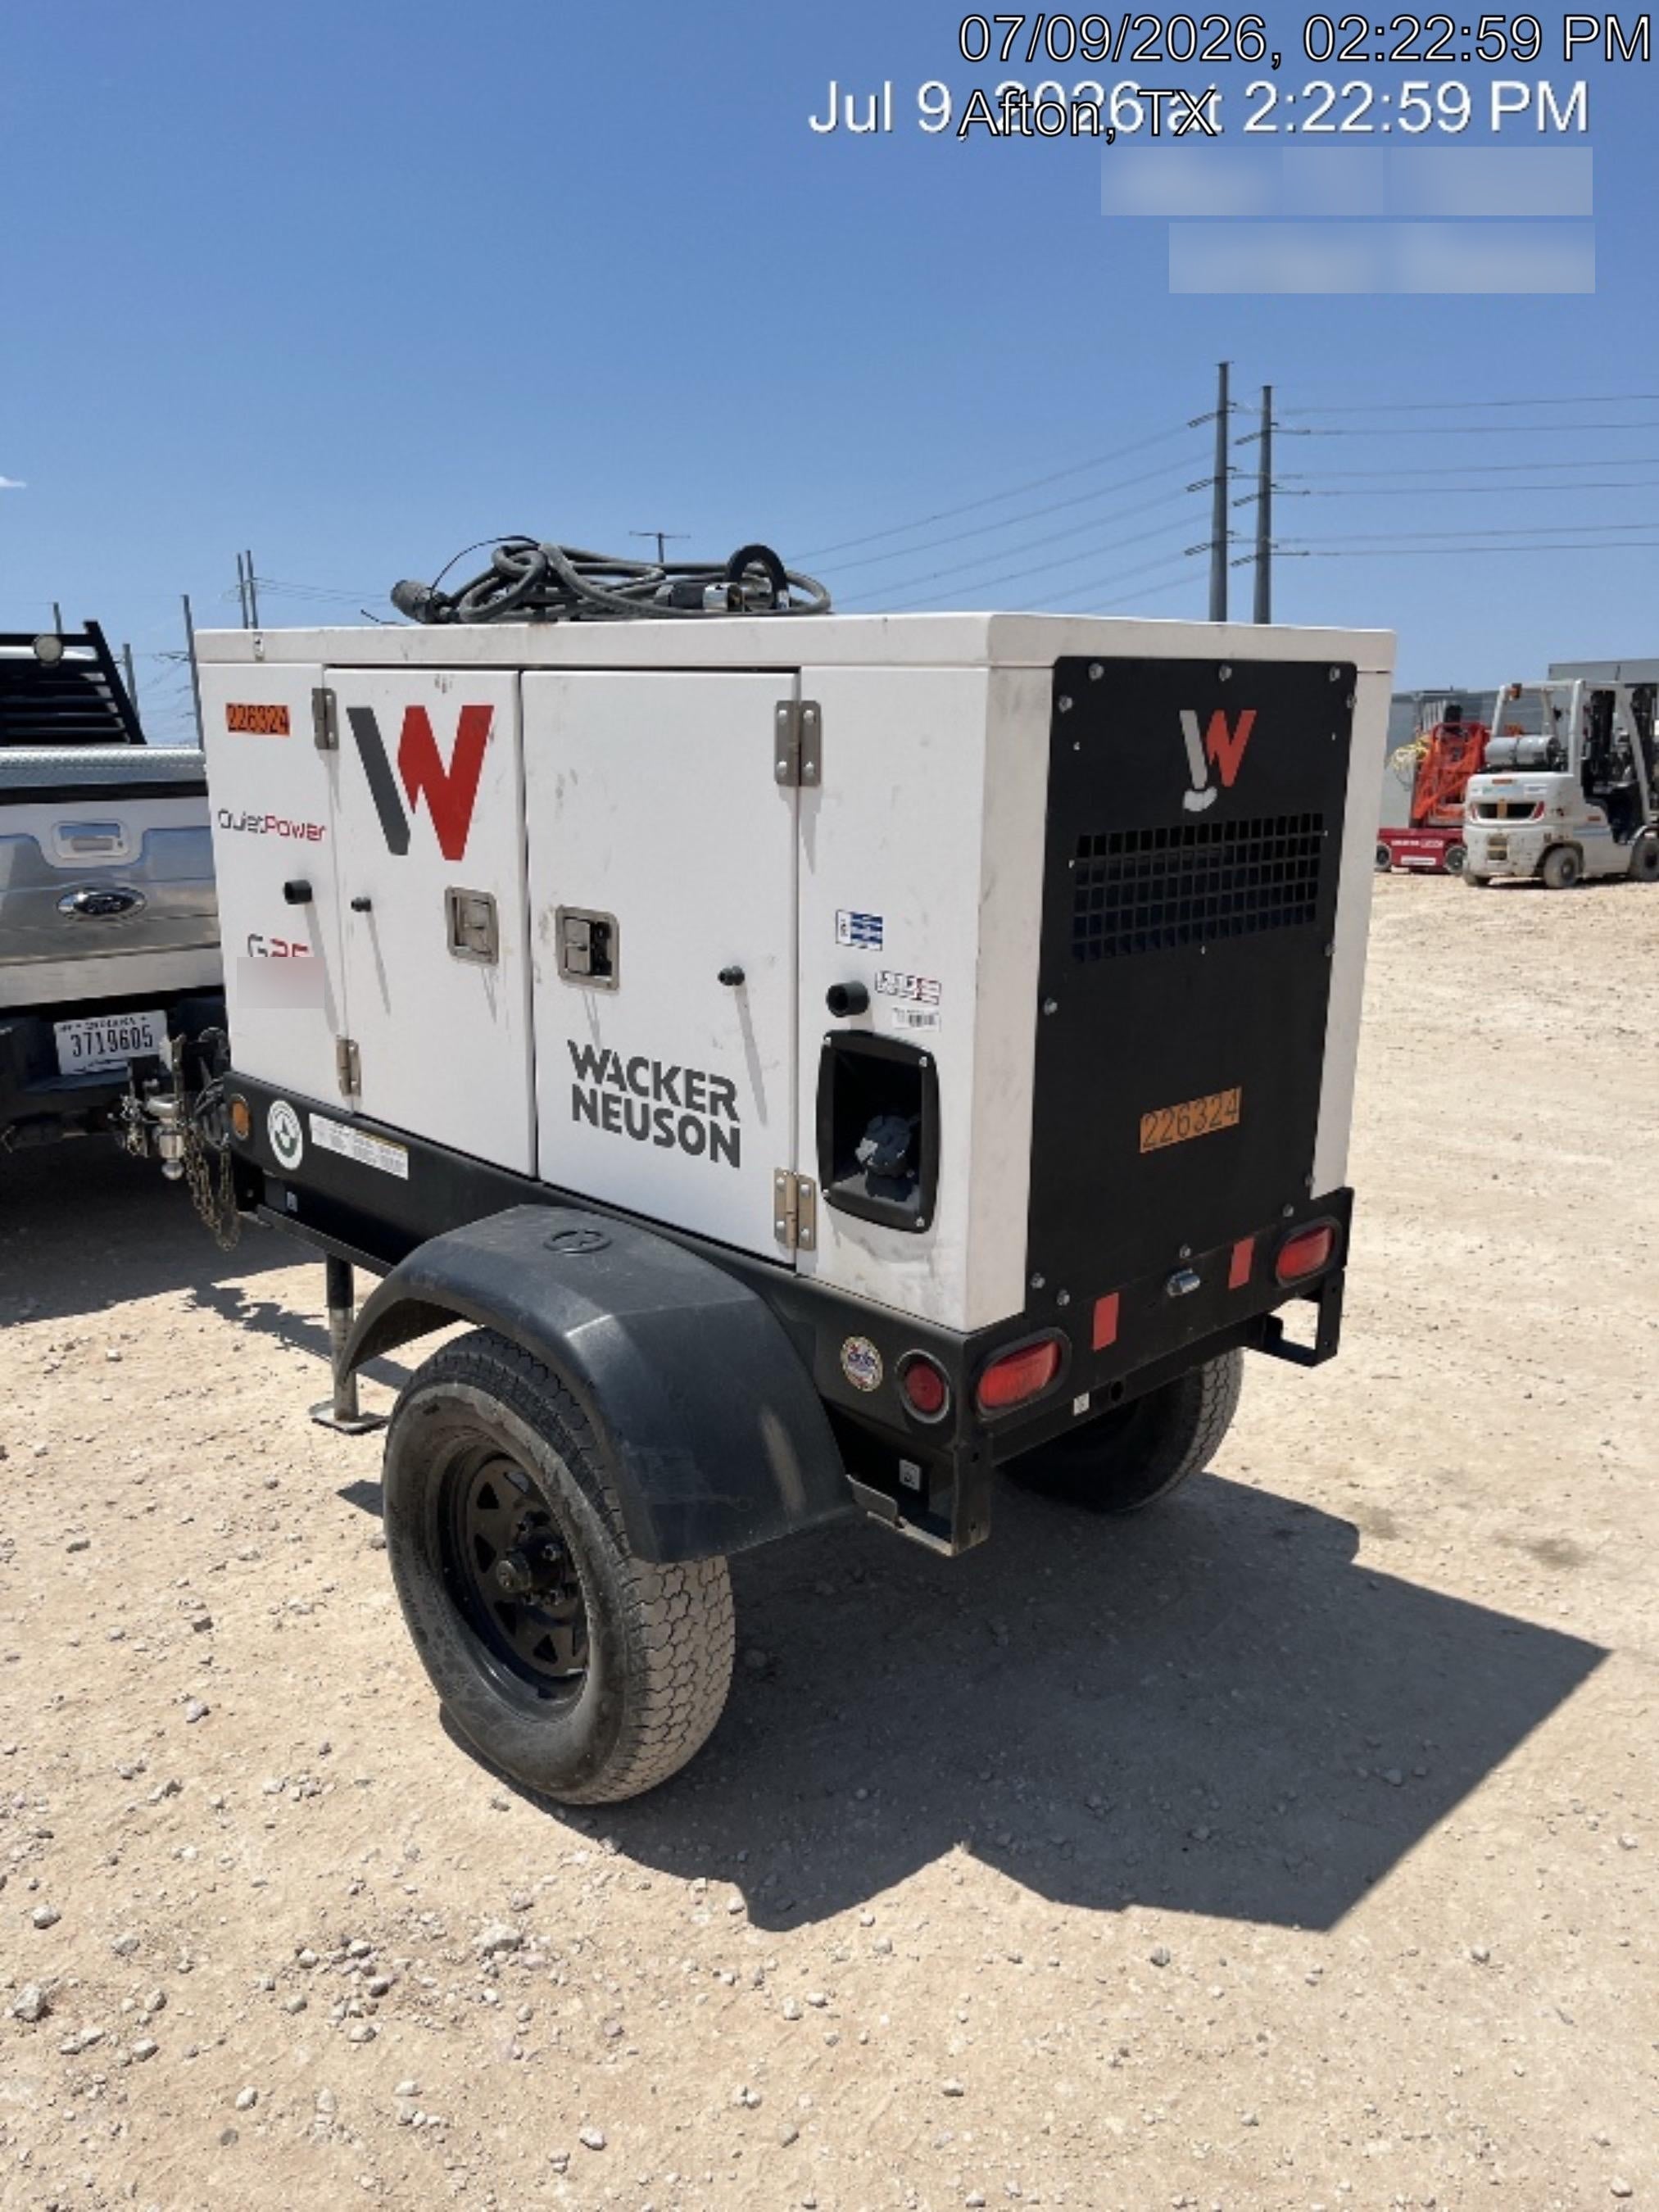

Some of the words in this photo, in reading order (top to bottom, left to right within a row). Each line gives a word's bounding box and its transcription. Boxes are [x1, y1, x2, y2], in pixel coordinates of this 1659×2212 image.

[227, 705, 289, 734] 226324
[70, 1024, 152, 1057] 3719605
[567, 1039, 741, 1122] WACKER
[572, 1084, 741, 1169] NEUSON
[1143, 1090, 1238, 1149] 226324
